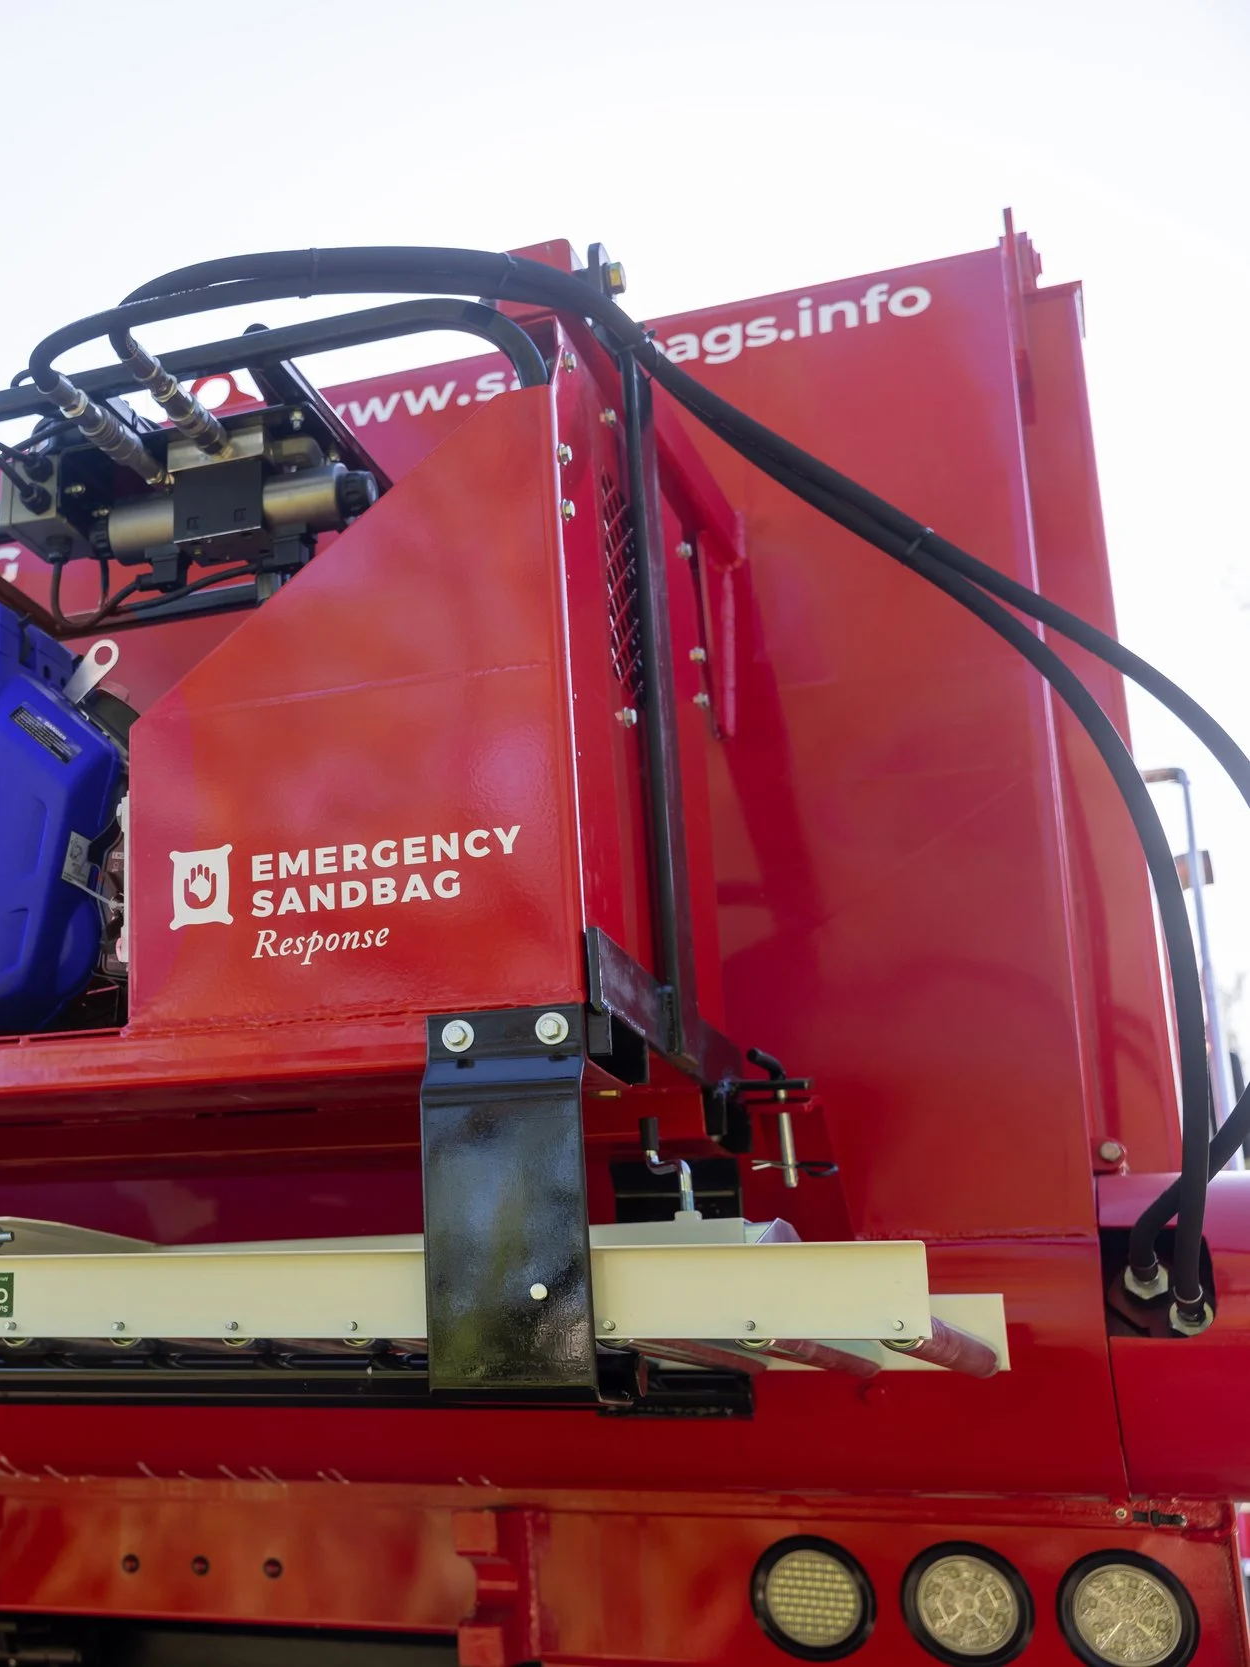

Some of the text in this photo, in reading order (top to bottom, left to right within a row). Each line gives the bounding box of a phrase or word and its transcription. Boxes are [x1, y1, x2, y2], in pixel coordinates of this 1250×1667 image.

[251, 825, 521, 882] EMERGENCY
[251, 870, 461, 918] SANDBAG
[252, 927, 390, 966] Response
